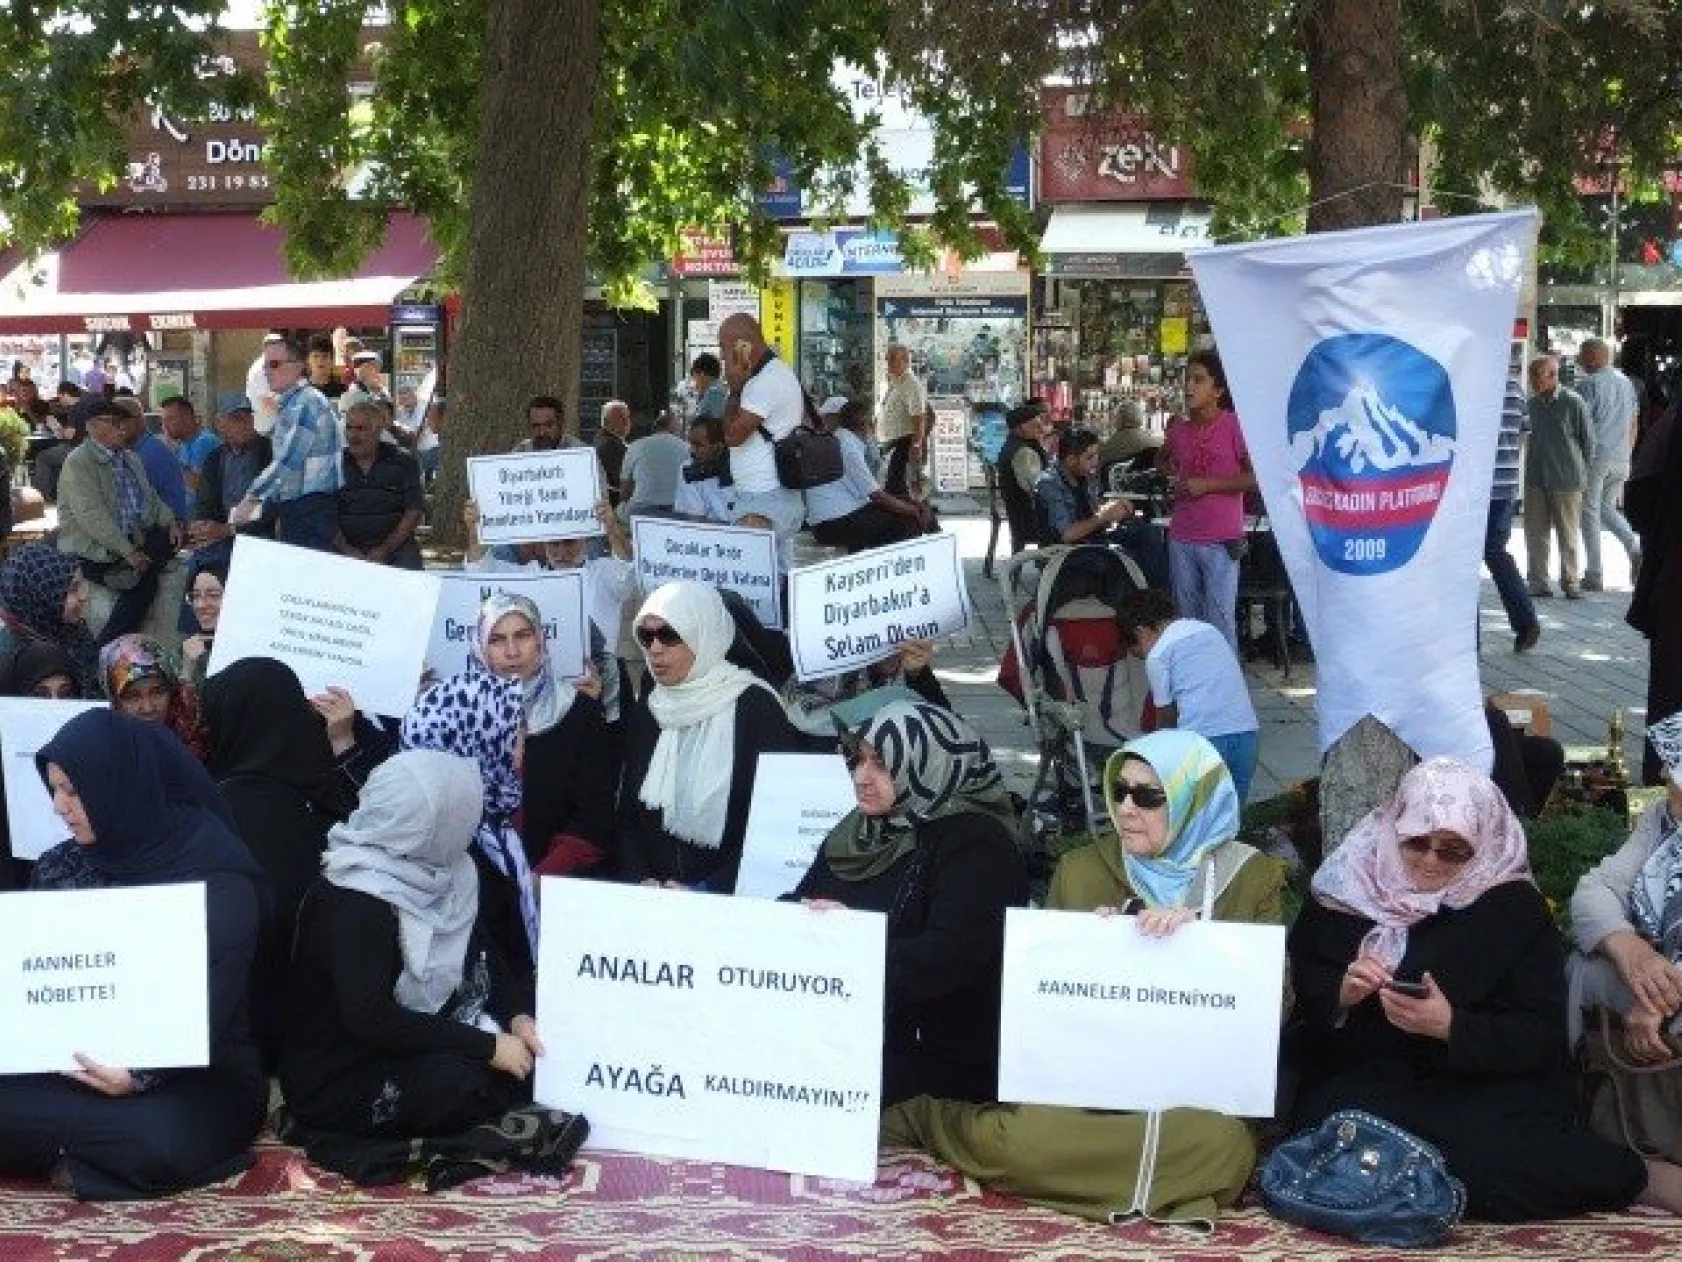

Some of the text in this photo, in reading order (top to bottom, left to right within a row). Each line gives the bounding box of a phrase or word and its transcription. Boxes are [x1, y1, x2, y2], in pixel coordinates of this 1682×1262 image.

[1345, 538, 1386, 561] 2009
[825, 555, 926, 592] Kayseri'den
[824, 584, 931, 626] Diyarbakır'a
[825, 620, 939, 660] Selam Olsun
[22, 951, 116, 973] #ANNELER
[577, 954, 694, 989] ANALAR
[27, 983, 116, 1005] NÖBETTE!
[1037, 979, 1236, 1010] #ANNELER DİRENİYOR
[585, 1063, 870, 1113] AYAĞA KALDIRMAYIN!!!
